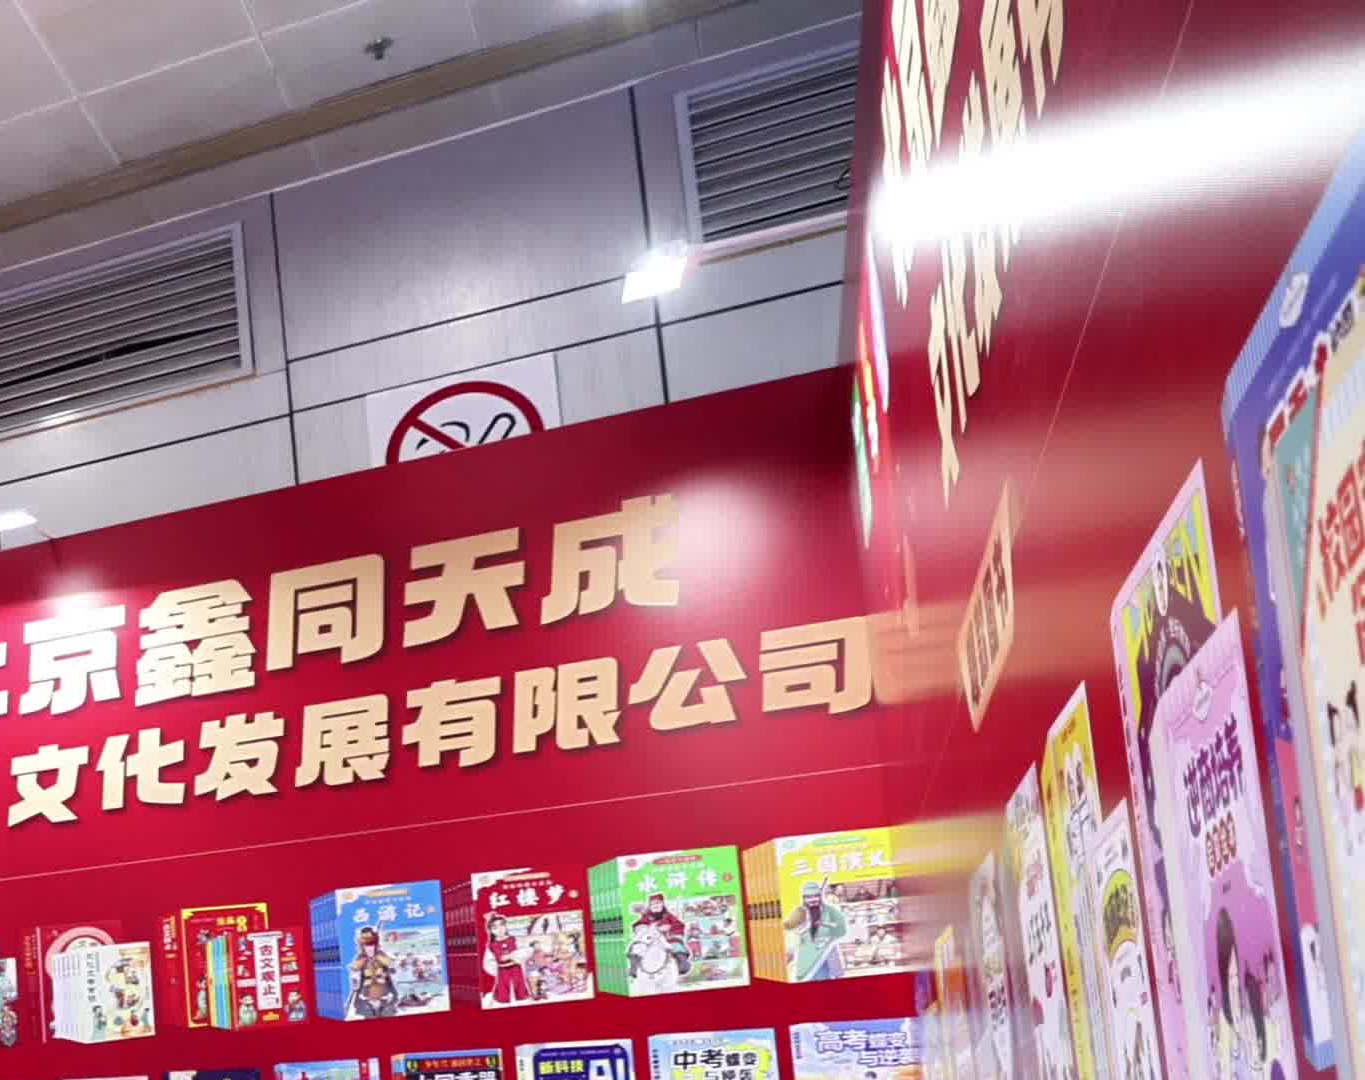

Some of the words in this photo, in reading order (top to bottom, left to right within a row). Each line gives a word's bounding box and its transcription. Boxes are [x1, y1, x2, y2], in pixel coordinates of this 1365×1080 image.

[7, 614, 875, 828] 文化发展有限公司
[637, 870, 720, 894] 水浒传
[489, 884, 565, 910] 红楼梦
[352, 905, 427, 925] 西游记
